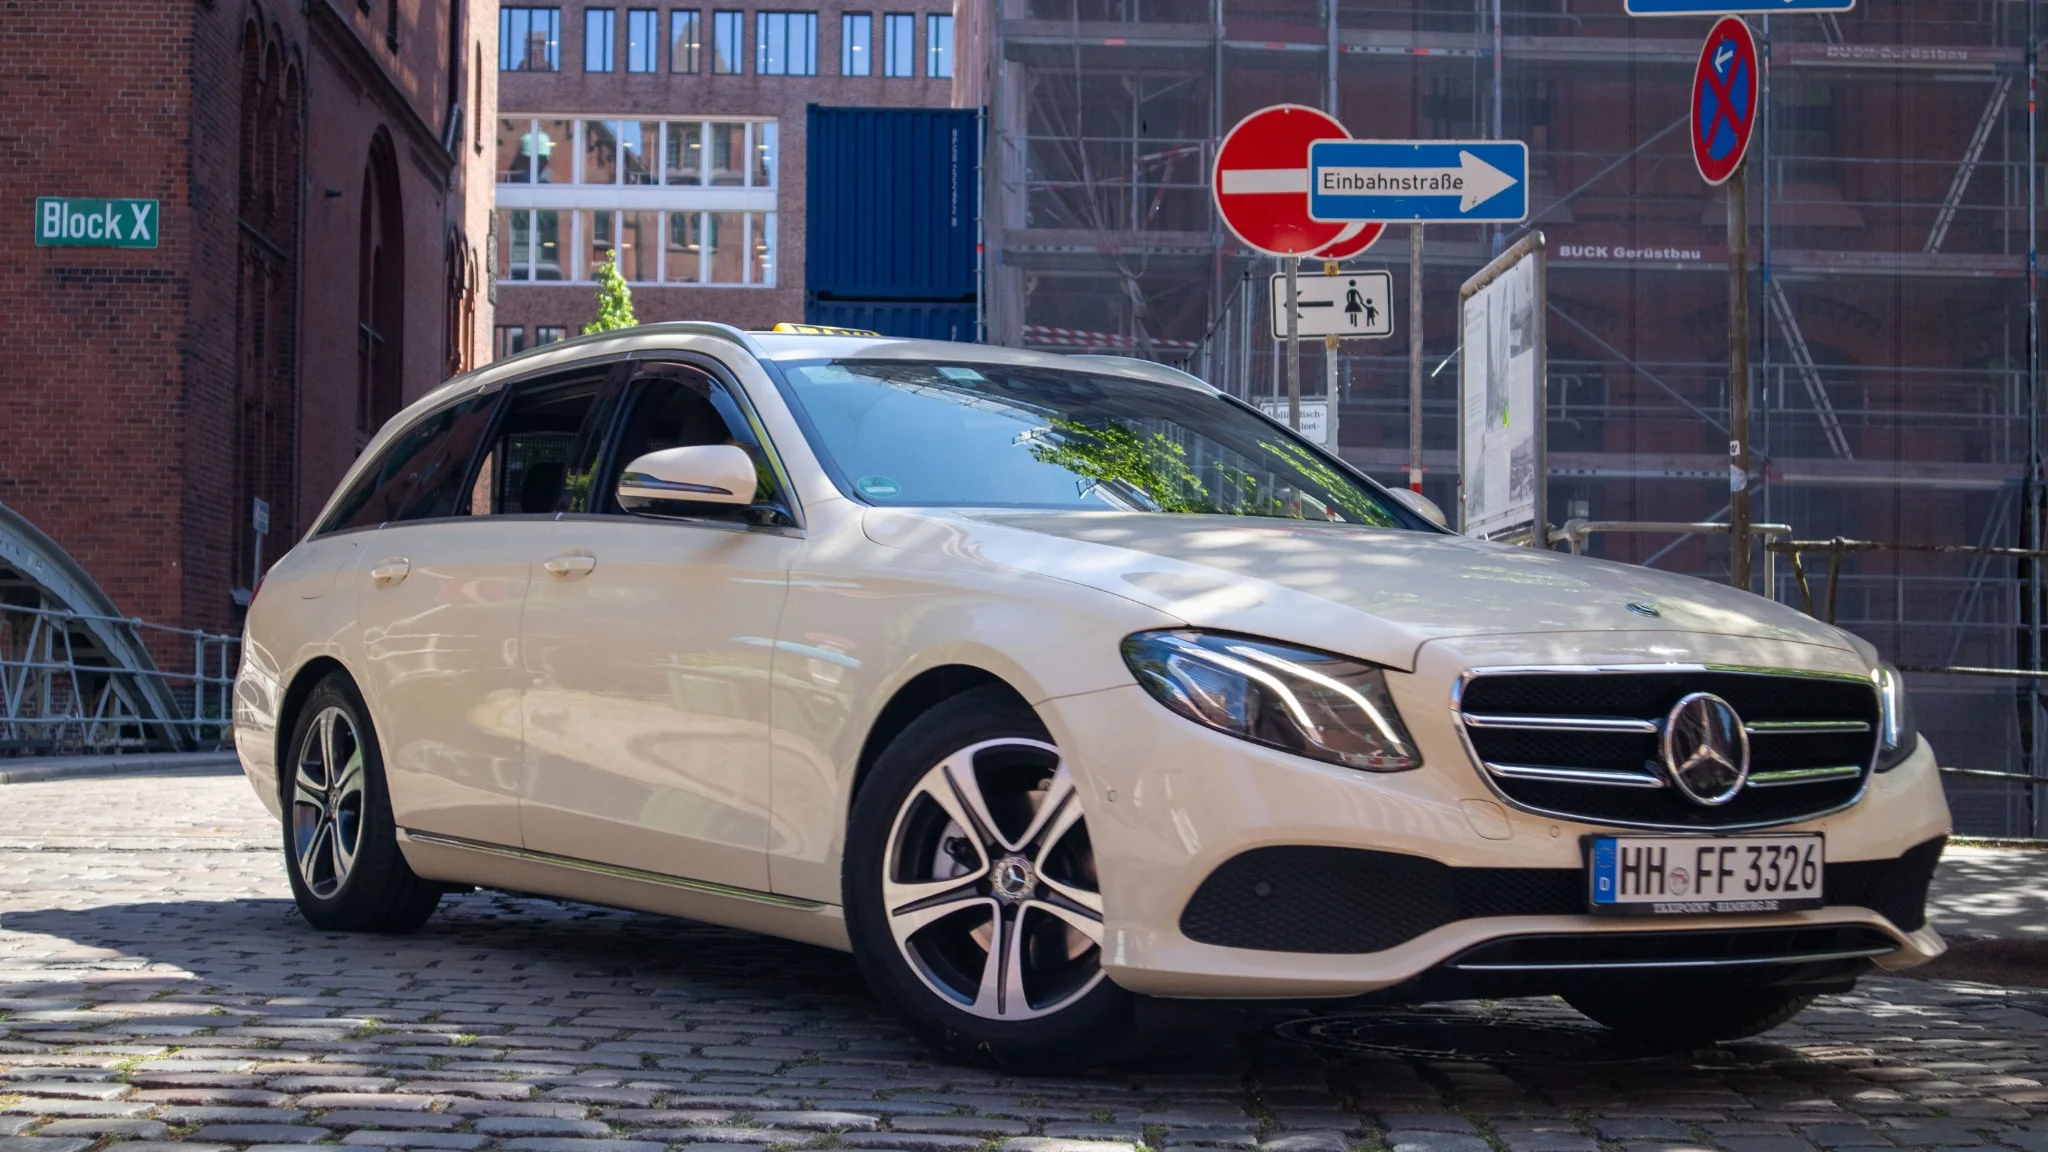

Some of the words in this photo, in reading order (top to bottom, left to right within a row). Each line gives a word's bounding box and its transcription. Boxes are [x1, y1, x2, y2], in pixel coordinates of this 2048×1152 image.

[1323, 172, 1464, 190] Einbahnstraße
[43, 201, 122, 240] Block
[130, 203, 151, 240] X
[1559, 245, 1609, 257] BUCK
[1613, 246, 1701, 260] Gerüstbau
[1620, 846, 1667, 895] HH
[1695, 846, 1737, 894] FF
[1745, 844, 1815, 893] 3326
[1599, 876, 1611, 892] D
